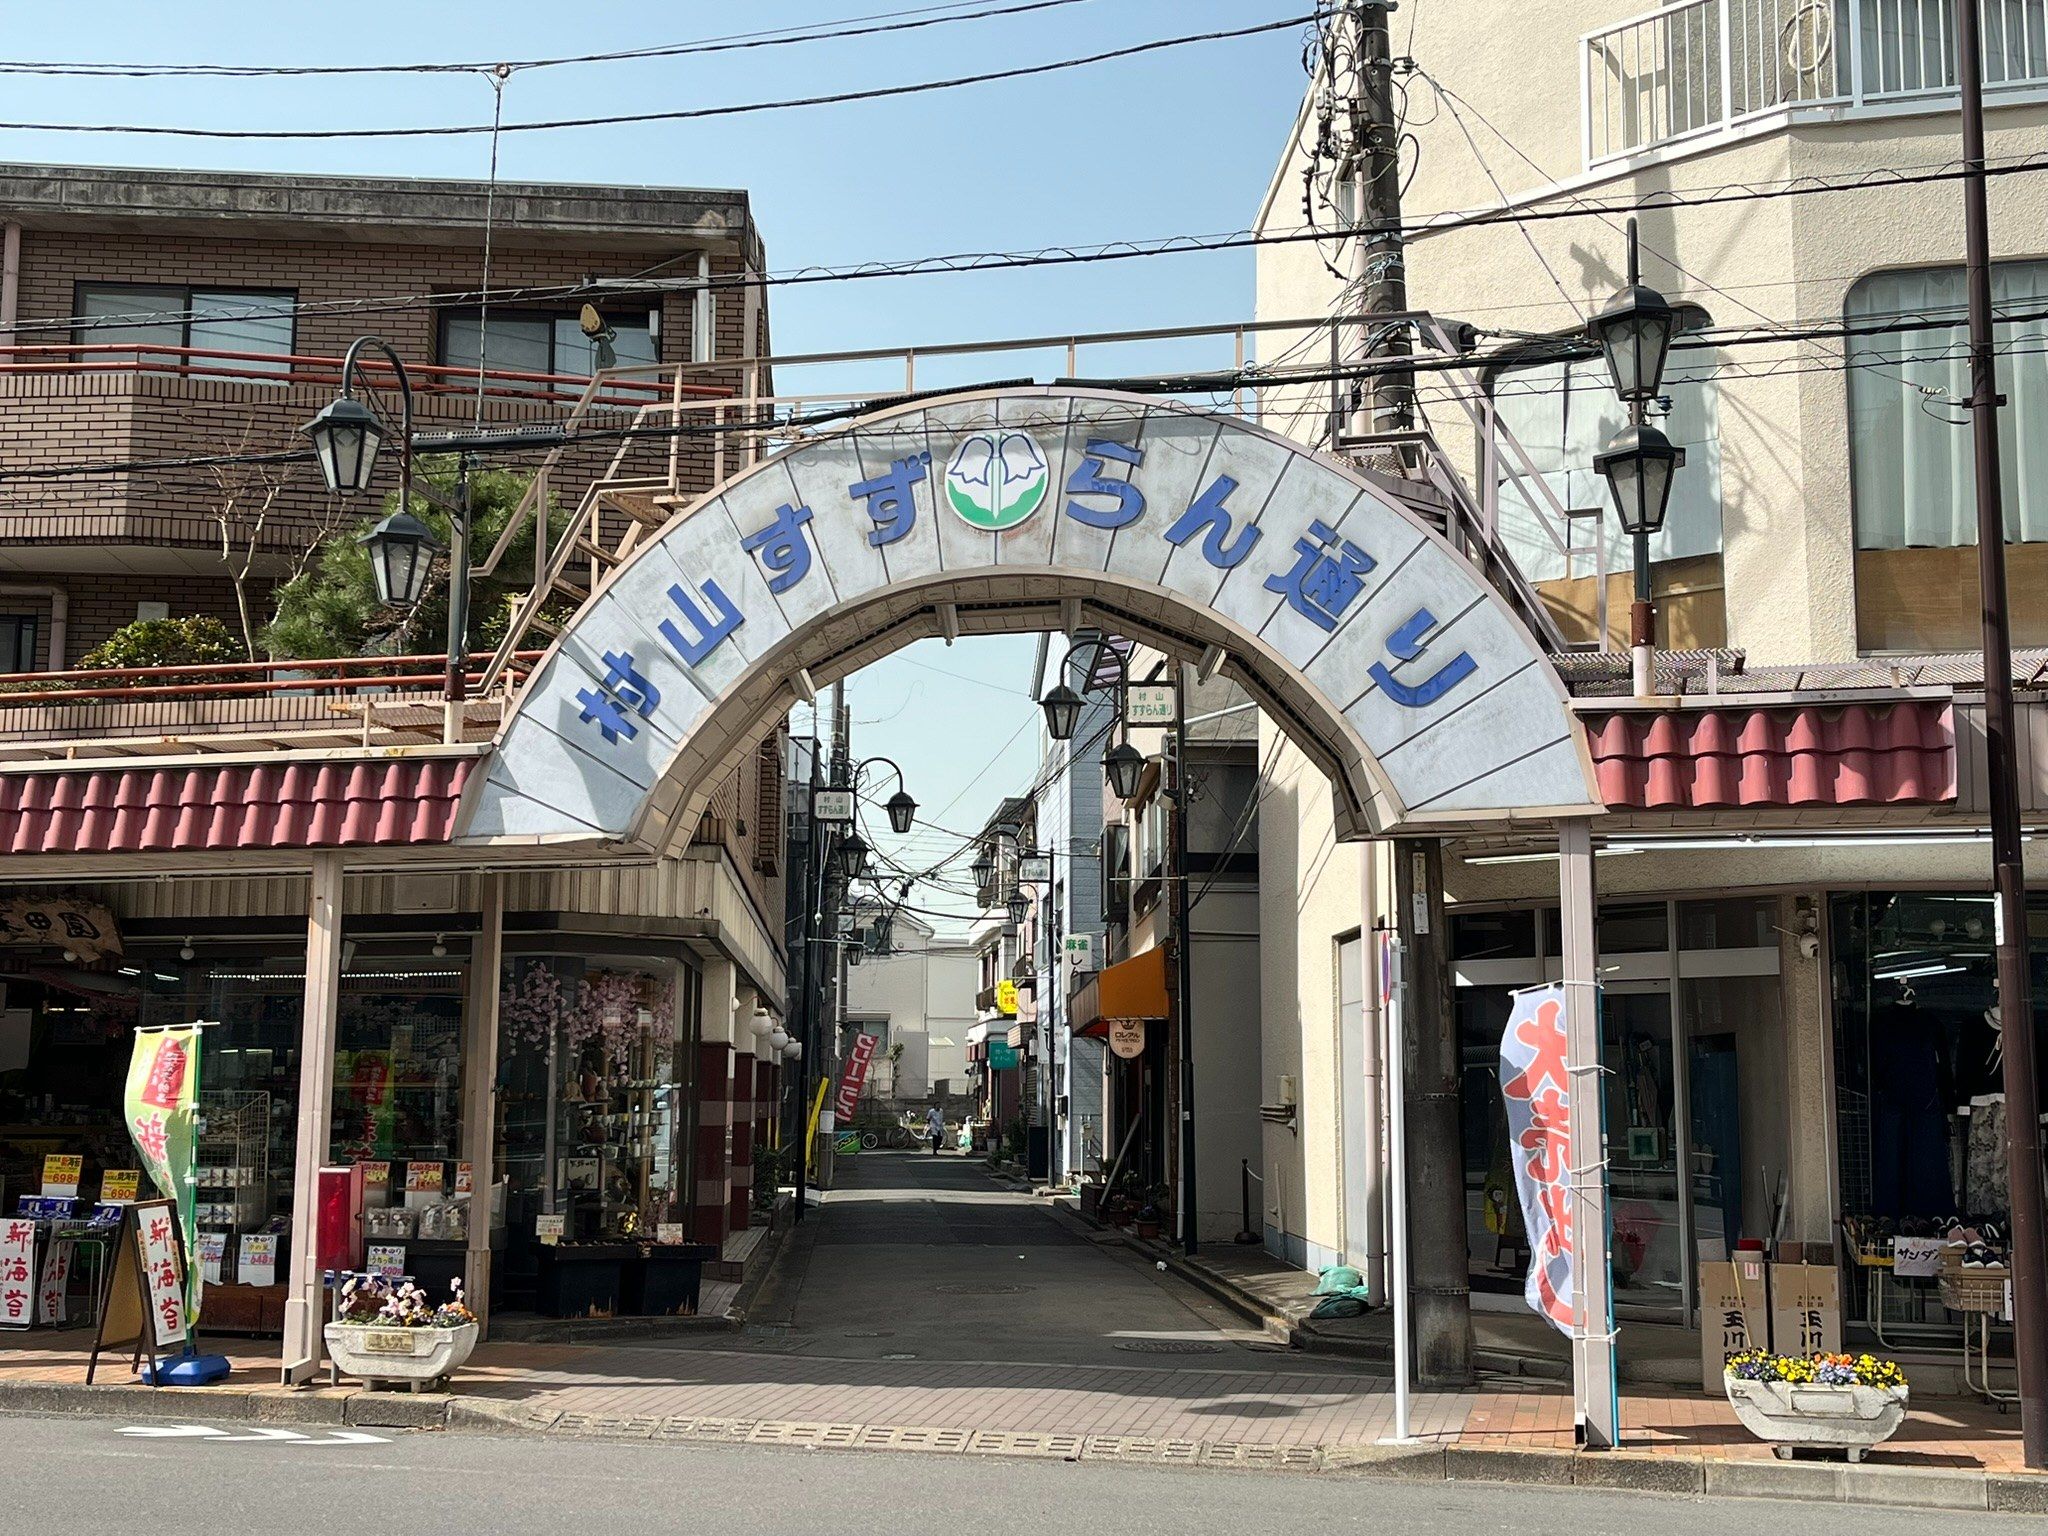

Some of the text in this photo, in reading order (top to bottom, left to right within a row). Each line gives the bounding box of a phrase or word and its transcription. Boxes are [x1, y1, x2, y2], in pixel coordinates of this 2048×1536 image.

[574, 437, 1479, 744] 村山すずらん通り
[1132, 704, 1173, 716] すずらん通り
[1138, 692, 1164, 701] 村山
[1065, 939, 1088, 950] 麻雀
[4, 1221, 31, 1318] 新海苔
[150, 1216, 180, 1331] 新海苔
[1799, 1310, 1823, 1358] 玉川
